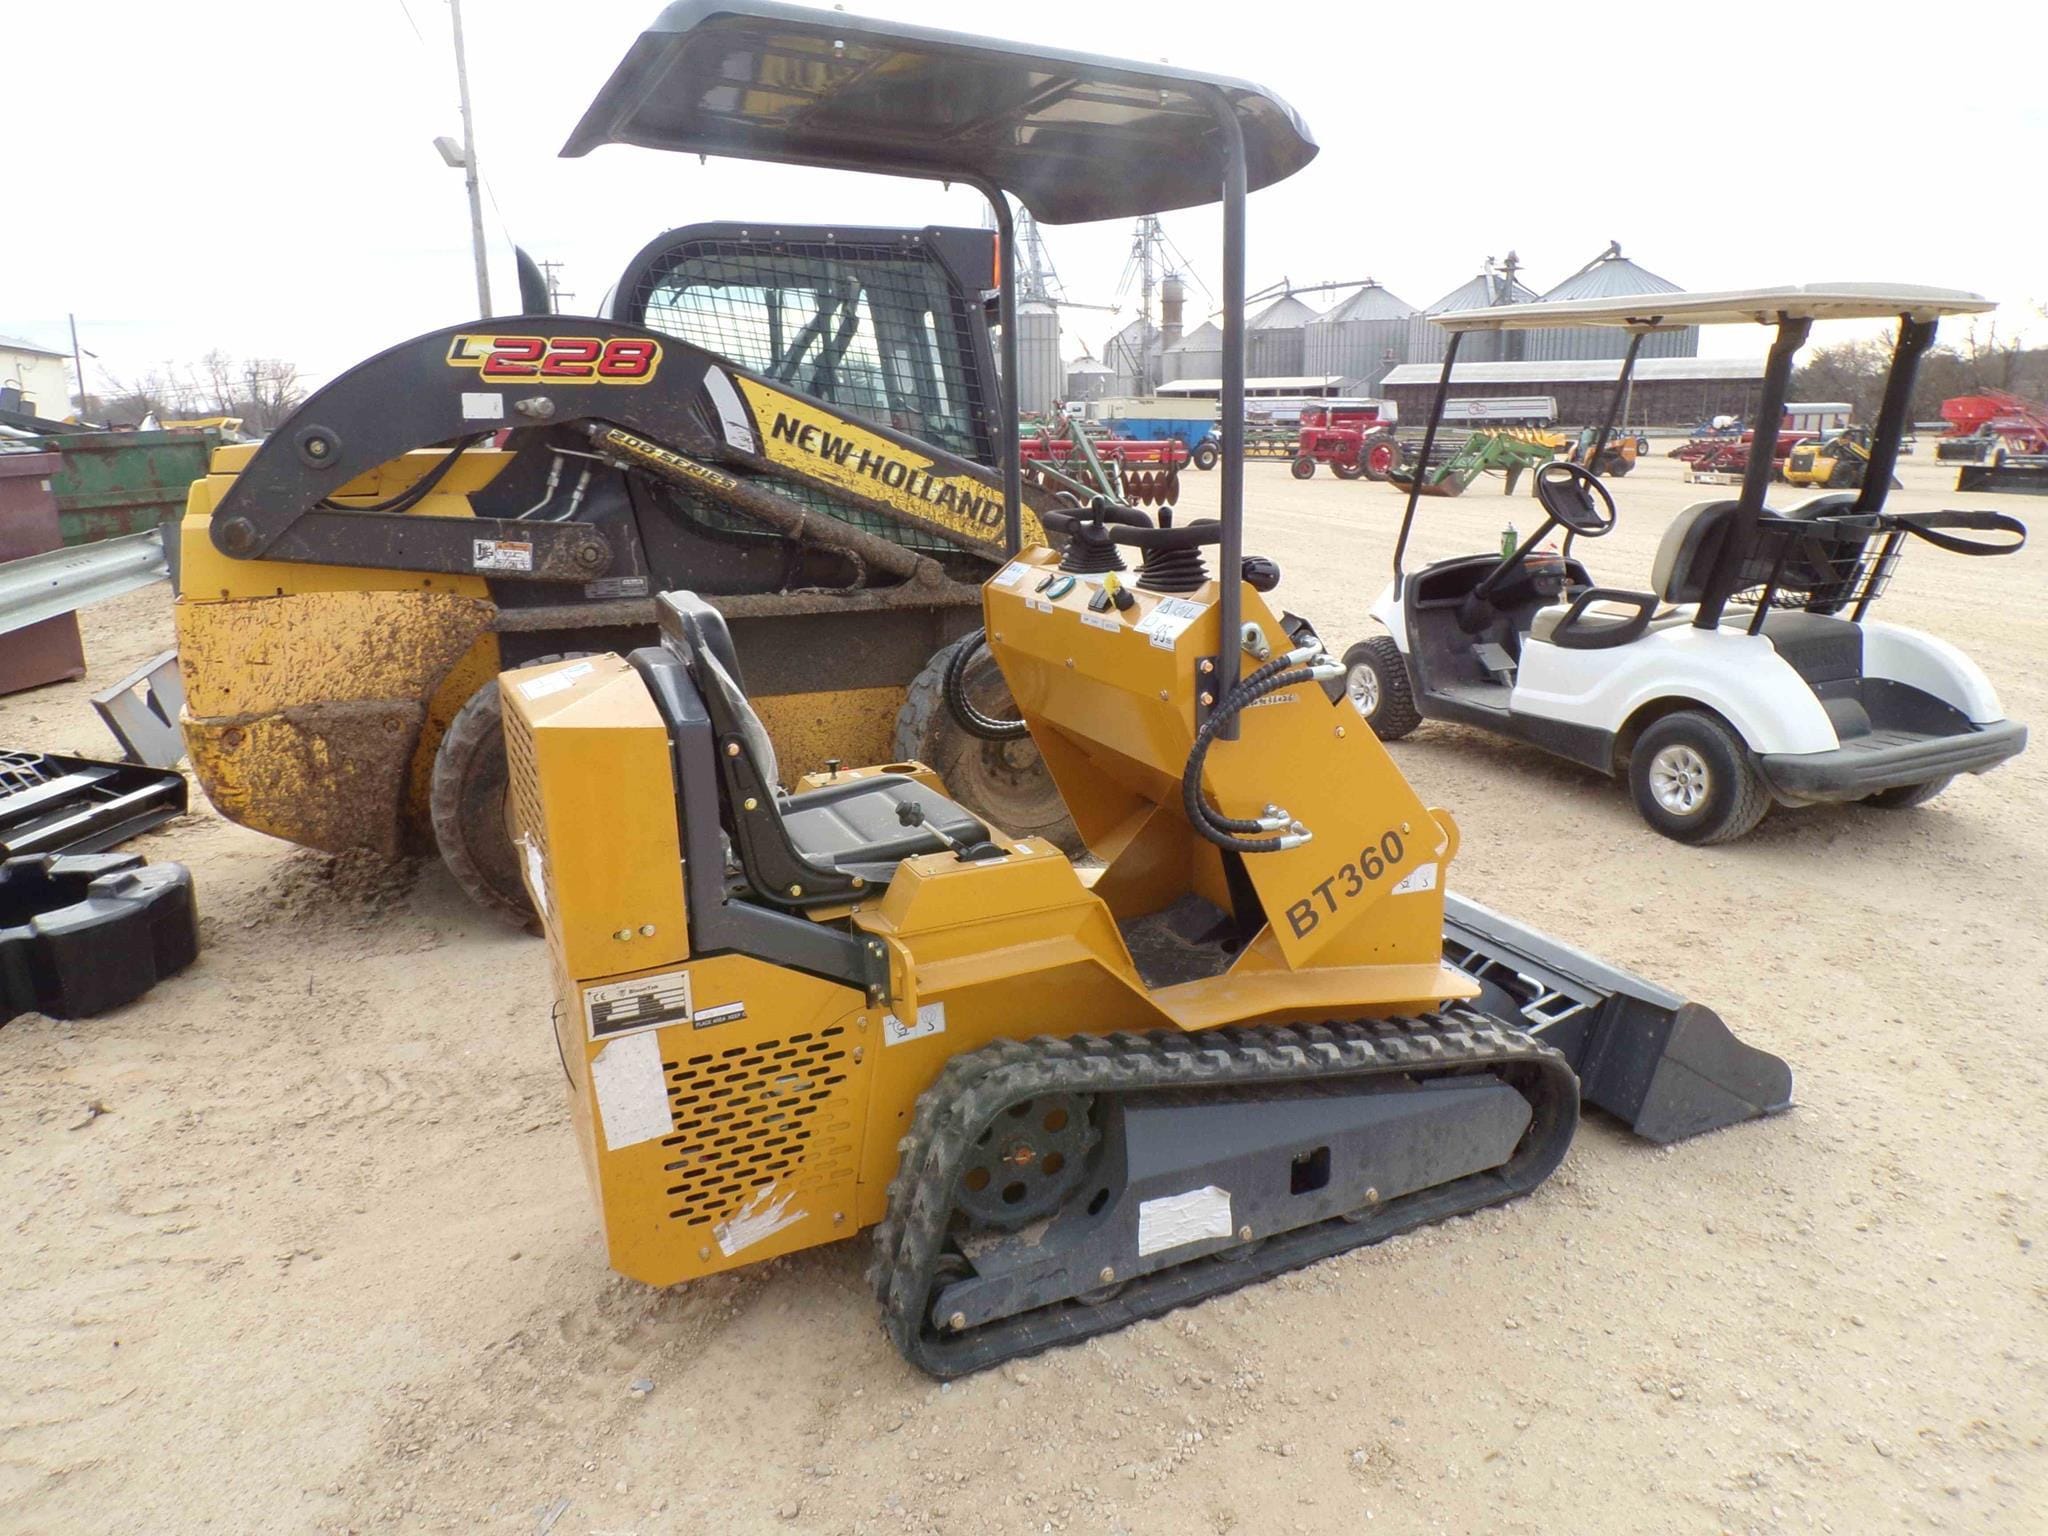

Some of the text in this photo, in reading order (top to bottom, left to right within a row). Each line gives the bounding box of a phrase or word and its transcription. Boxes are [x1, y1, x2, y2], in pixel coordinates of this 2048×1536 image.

[771, 412, 1004, 527] NEW HOLLAND
[1285, 830, 1404, 940] BT360
